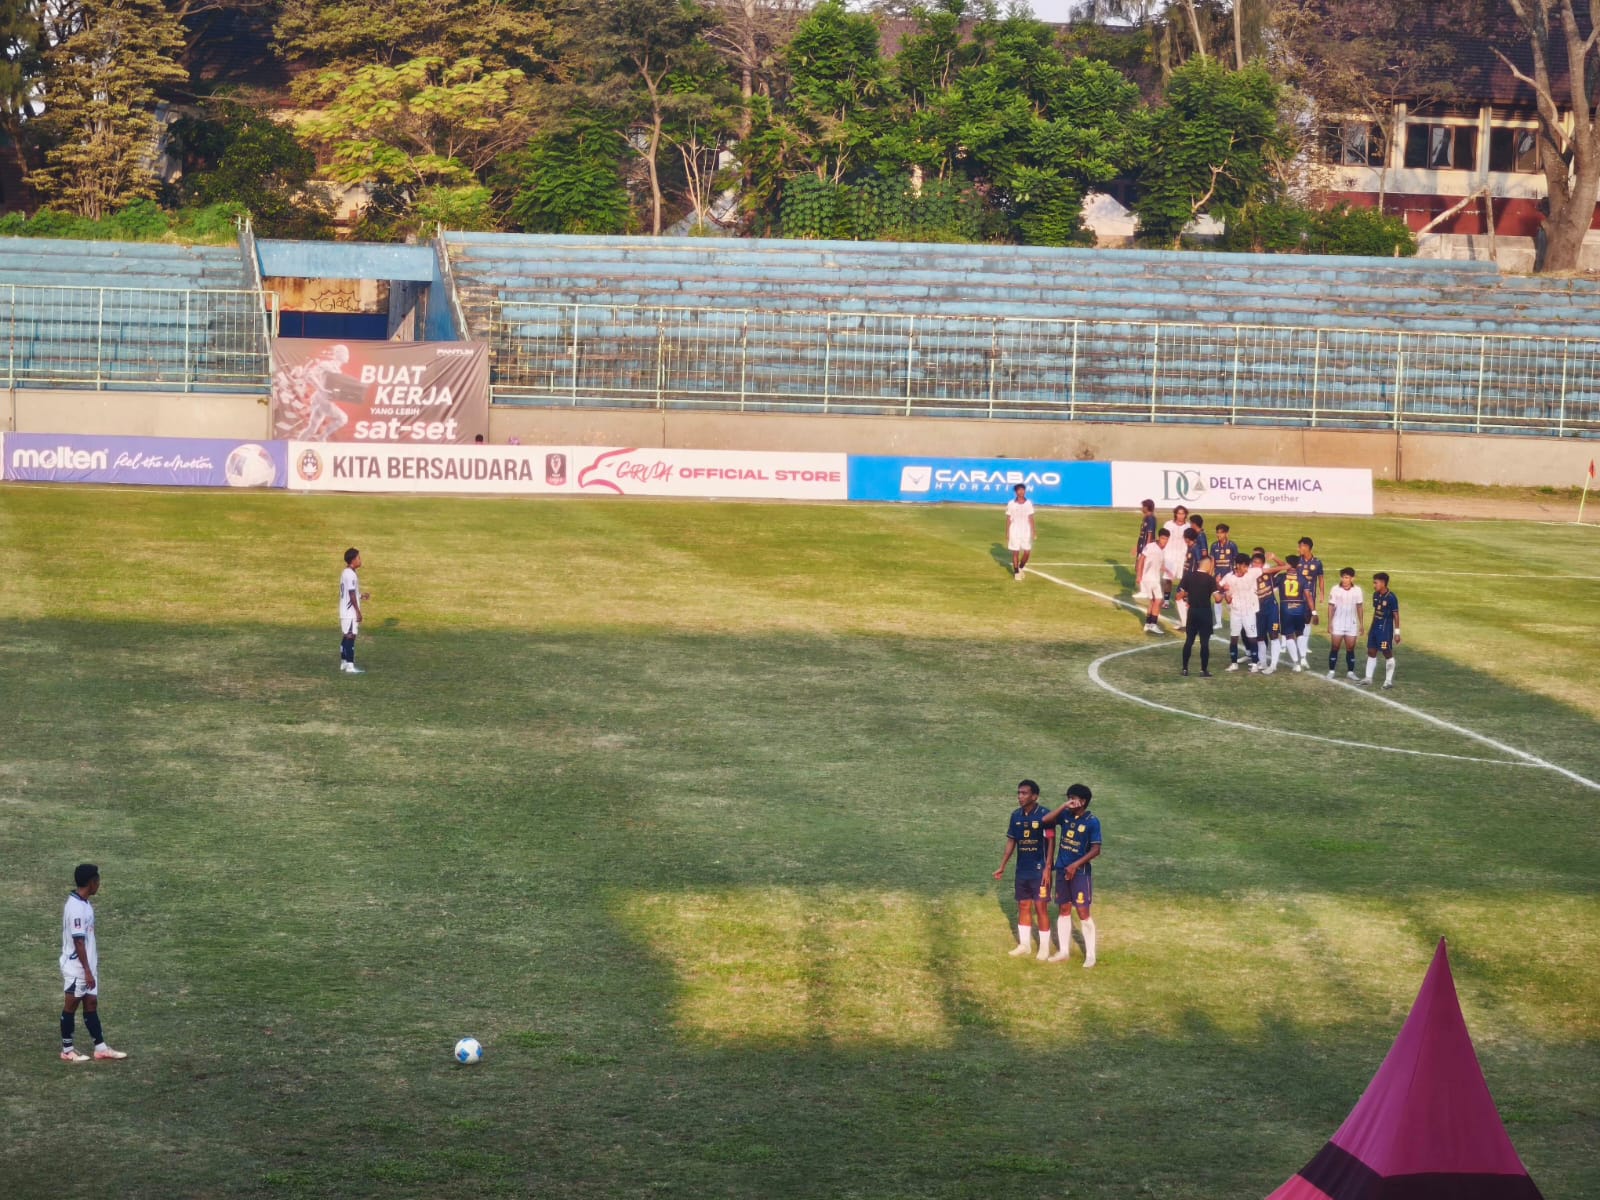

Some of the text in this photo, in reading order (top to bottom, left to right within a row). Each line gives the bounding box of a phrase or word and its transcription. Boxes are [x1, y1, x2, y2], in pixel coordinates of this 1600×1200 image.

[360, 364, 426, 385] BUAT
[374, 386, 453, 406] KERJA
[370, 407, 420, 416] YANG LEBIH
[353, 417, 458, 441] sat-set
[13, 446, 107, 470] molten
[332, 455, 533, 481] KITA BERSAUDARA
[616, 460, 674, 483] GARUDA
[678, 467, 841, 482] OFFICIAL STORE
[934, 469, 1061, 485] CARABAO
[935, 482, 1034, 492] HYDRATIN
[1209, 476, 1323, 492] DELTA CHEMICA
[1229, 492, 1299, 505] Grow Together
[1284, 579, 1299, 597] 12
